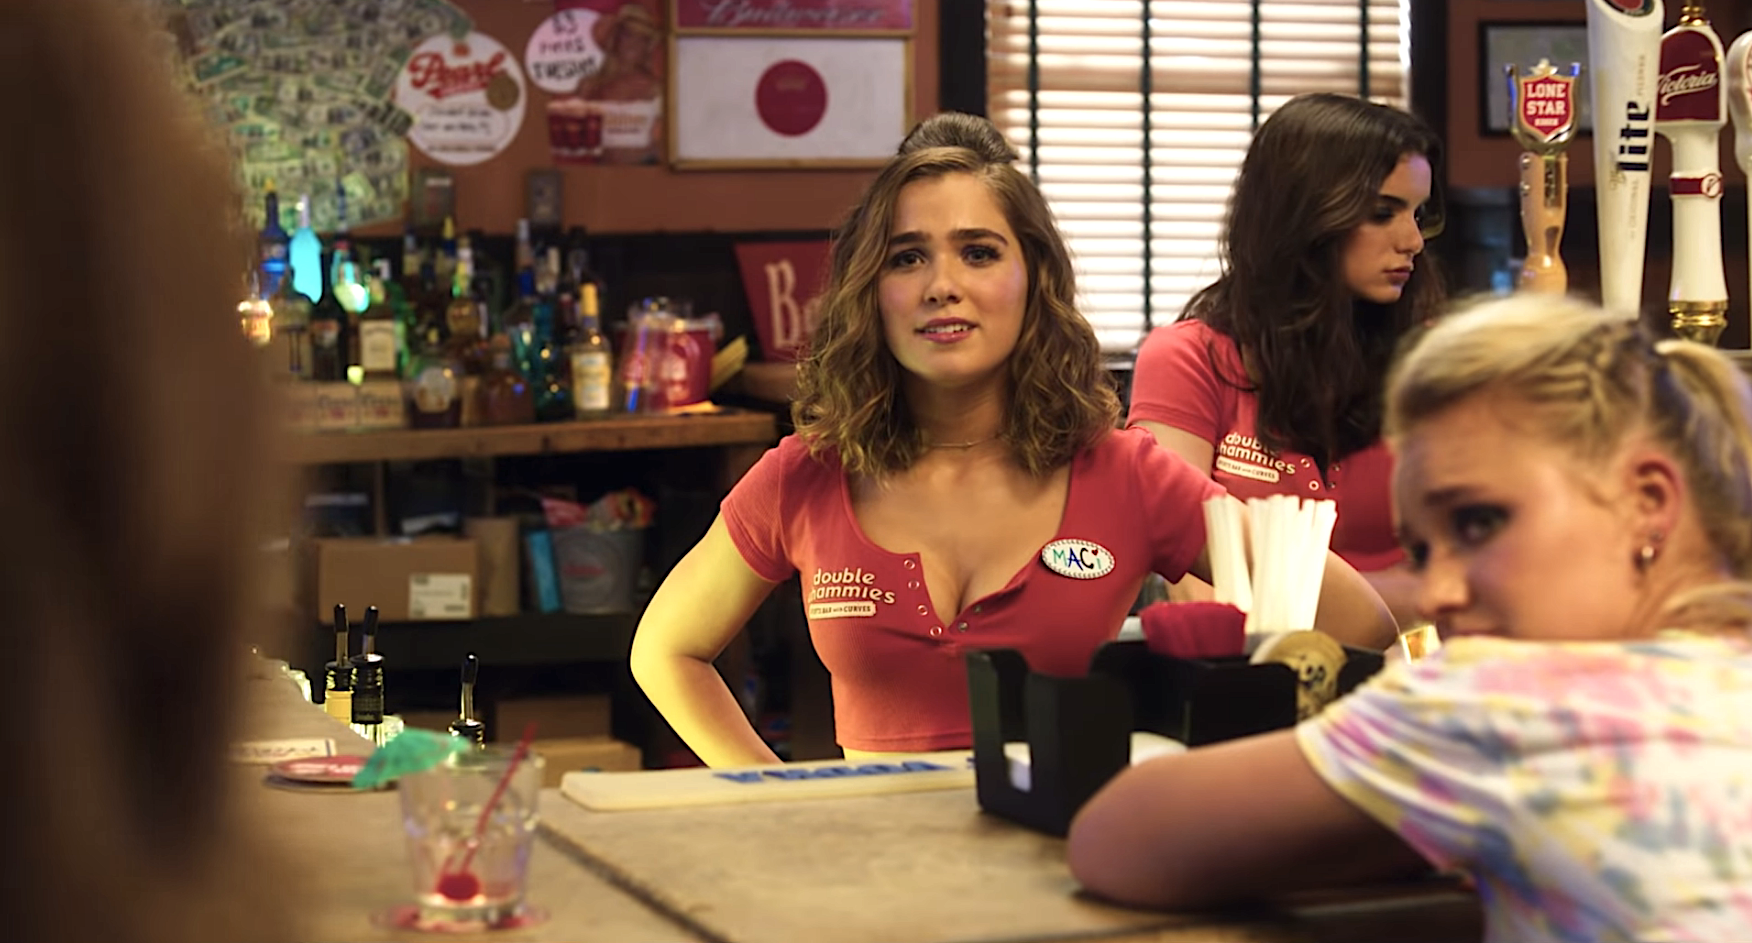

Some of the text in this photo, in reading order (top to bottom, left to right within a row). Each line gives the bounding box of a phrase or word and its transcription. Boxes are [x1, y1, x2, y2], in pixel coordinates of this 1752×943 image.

[407, 51, 505, 99] Pearl
[1527, 83, 1566, 98] LONE
[1656, 64, 1718, 106] Victoria
[1526, 100, 1566, 115] STAR
[1616, 101, 1649, 171] lite
[813, 567, 875, 586] double
[844, 605, 871, 613] CURVES
